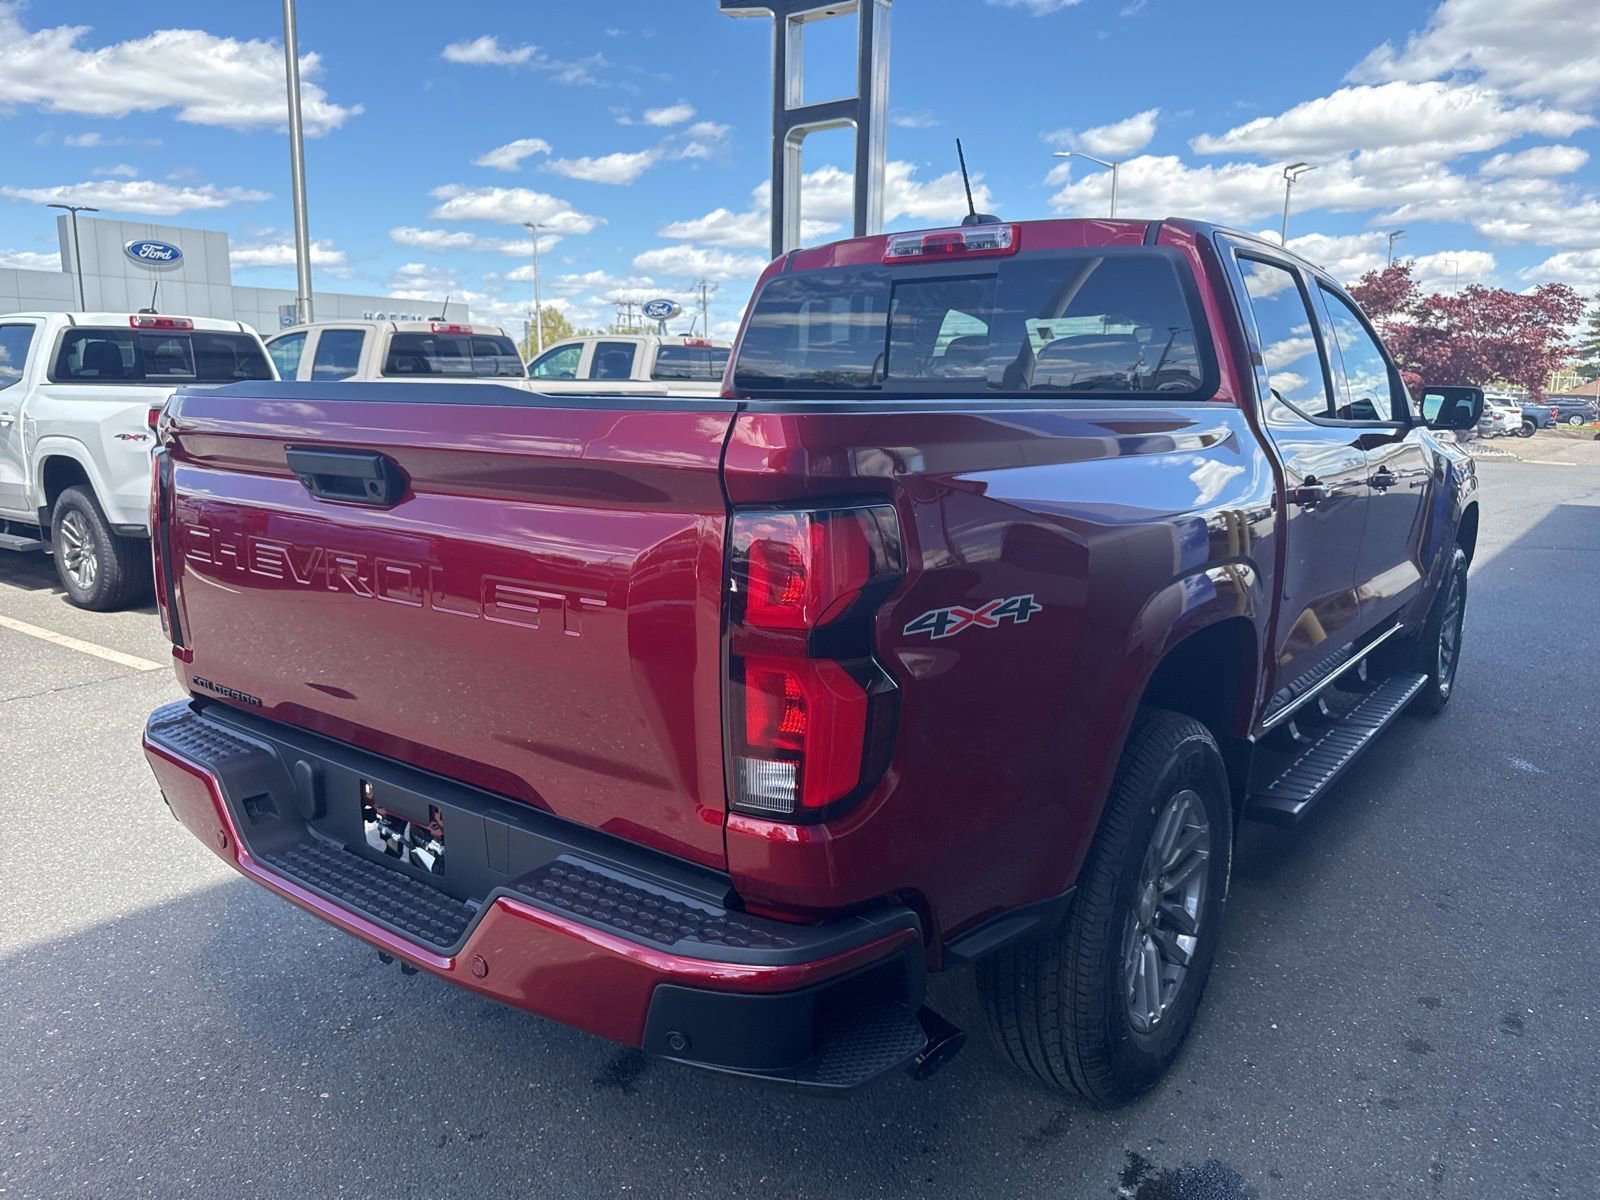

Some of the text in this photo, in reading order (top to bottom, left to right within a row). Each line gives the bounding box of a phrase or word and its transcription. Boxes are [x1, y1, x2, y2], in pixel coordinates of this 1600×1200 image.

[139, 243, 172, 260] Ford
[648, 303, 669, 316] Ford
[184, 523, 607, 637] CHEVROLET
